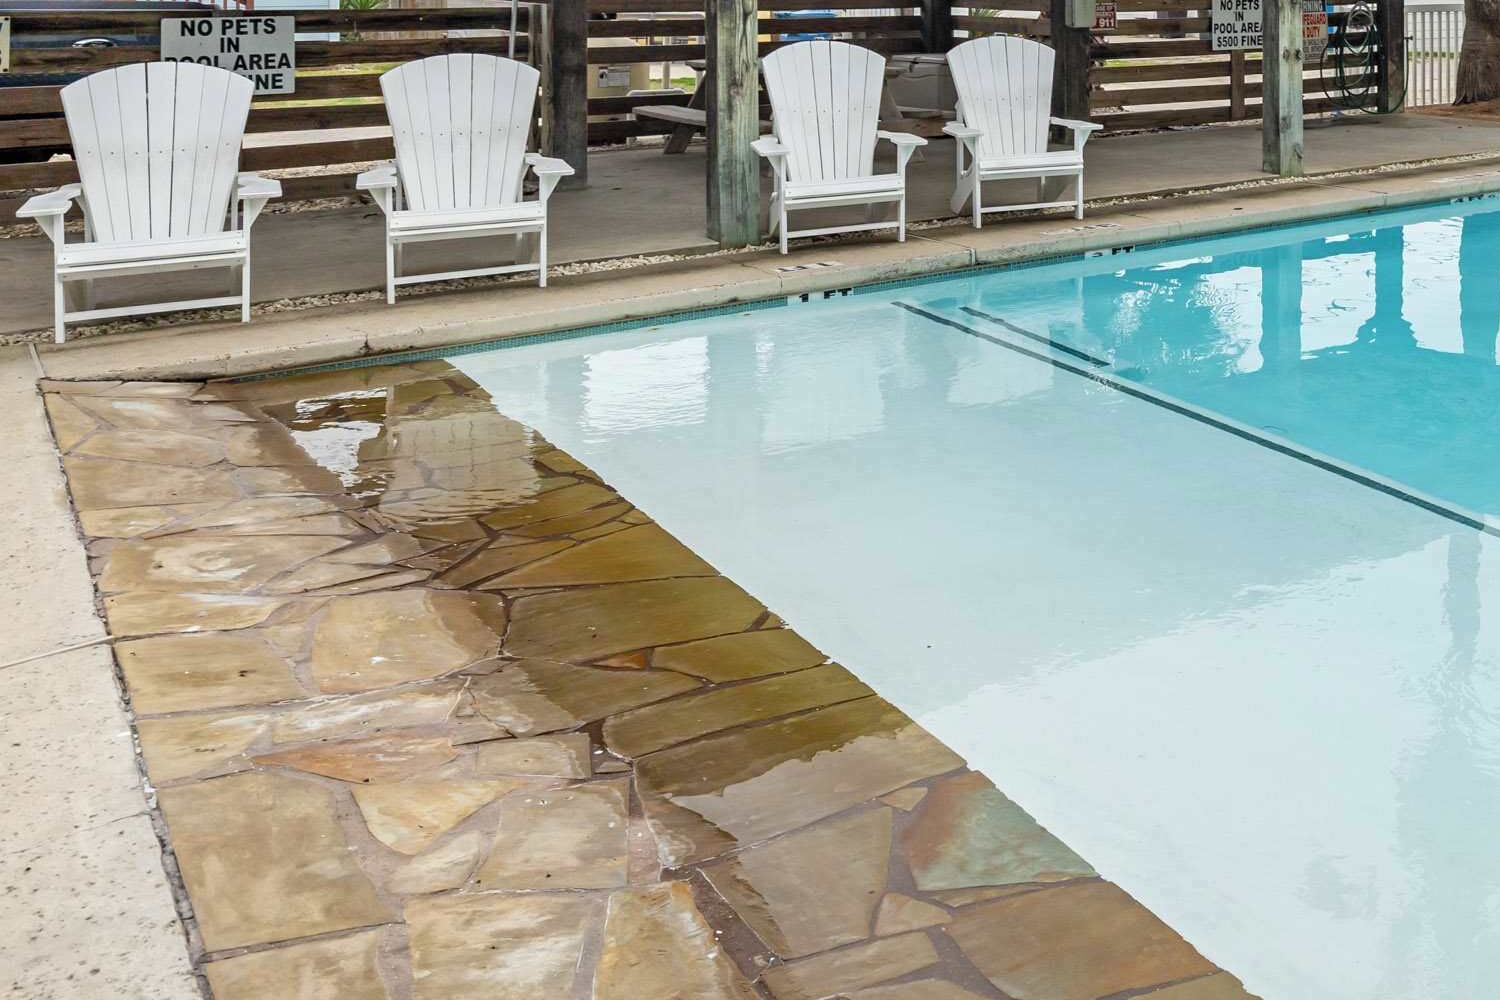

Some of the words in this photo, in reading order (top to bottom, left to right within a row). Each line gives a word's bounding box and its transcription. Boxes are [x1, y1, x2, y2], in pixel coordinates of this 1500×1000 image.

[1220, 0, 1233, 11] NO
[1235, 0, 1260, 10] PETS
[1235, 11, 1244, 21] IN
[181, 20, 213, 36] NO
[221, 18, 276, 36] PETS
[1099, 18, 1115, 28] 911
[1213, 23, 1238, 34] POOL
[220, 37, 240, 53] IN
[1217, 36, 1239, 47] $500
[1241, 35, 1263, 46] FINE
[233, 53, 291, 71] AREA
[823, 288, 853, 300] FT
